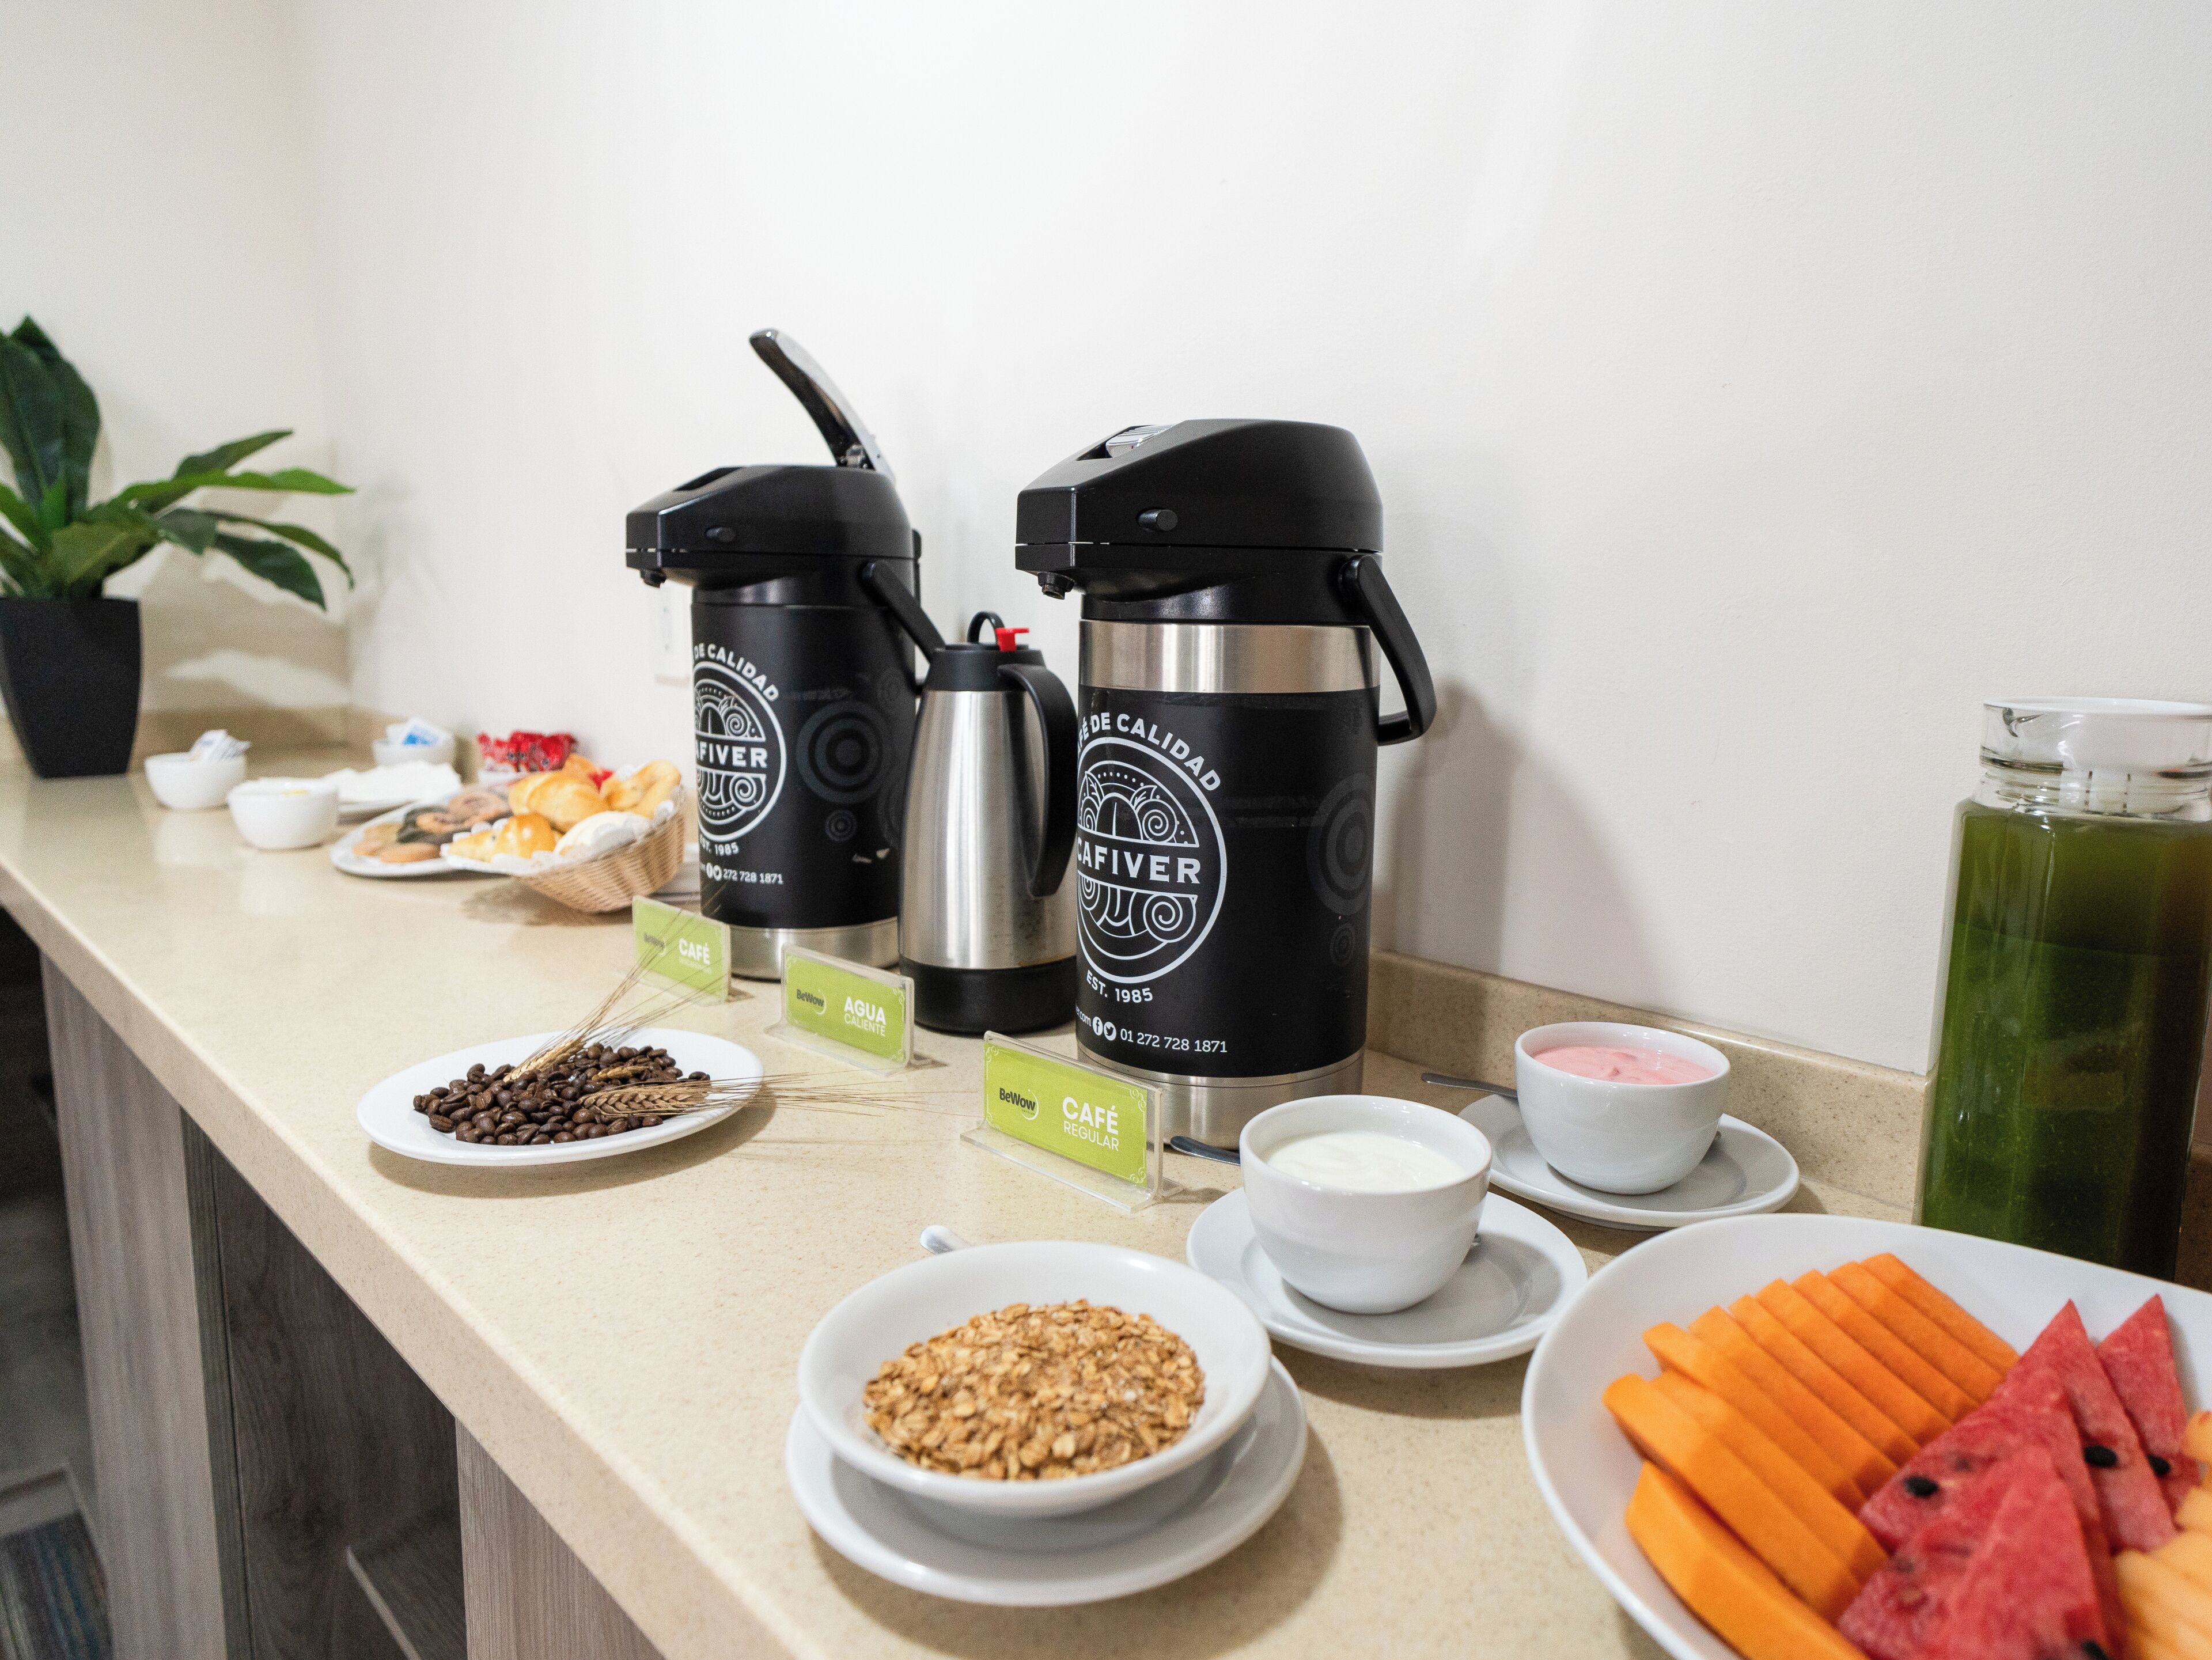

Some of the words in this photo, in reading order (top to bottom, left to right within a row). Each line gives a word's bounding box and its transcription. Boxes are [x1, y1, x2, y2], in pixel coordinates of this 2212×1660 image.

[694, 643, 705, 661] DE
[707, 643, 779, 702] CALIDAD
[1090, 712, 1111, 733] DE
[1116, 713, 1221, 791] CALIDAD
[714, 842, 740, 856] 1985
[1077, 836, 1200, 884] CAFIVER
[723, 868, 738, 881] 272
[739, 870, 757, 884] 728
[759, 872, 784, 885] 1871
[679, 938, 710, 965] CAFÉ
[796, 988, 824, 1007] BeWow
[1086, 969, 1108, 998] EST.
[1115, 988, 1153, 1003] 1985
[844, 996, 887, 1025] AGUA
[844, 1013, 885, 1036] CALIENTE
[1120, 1028, 1134, 1043] 01
[1137, 1032, 1160, 1047] 272
[1164, 1037, 1190, 1051] 728
[1194, 1040, 1228, 1053] 1871
[999, 1087, 1036, 1111] BeWow
[1062, 1097, 1118, 1135] CAFÉ
[1064, 1121, 1119, 1152] REGULAR
